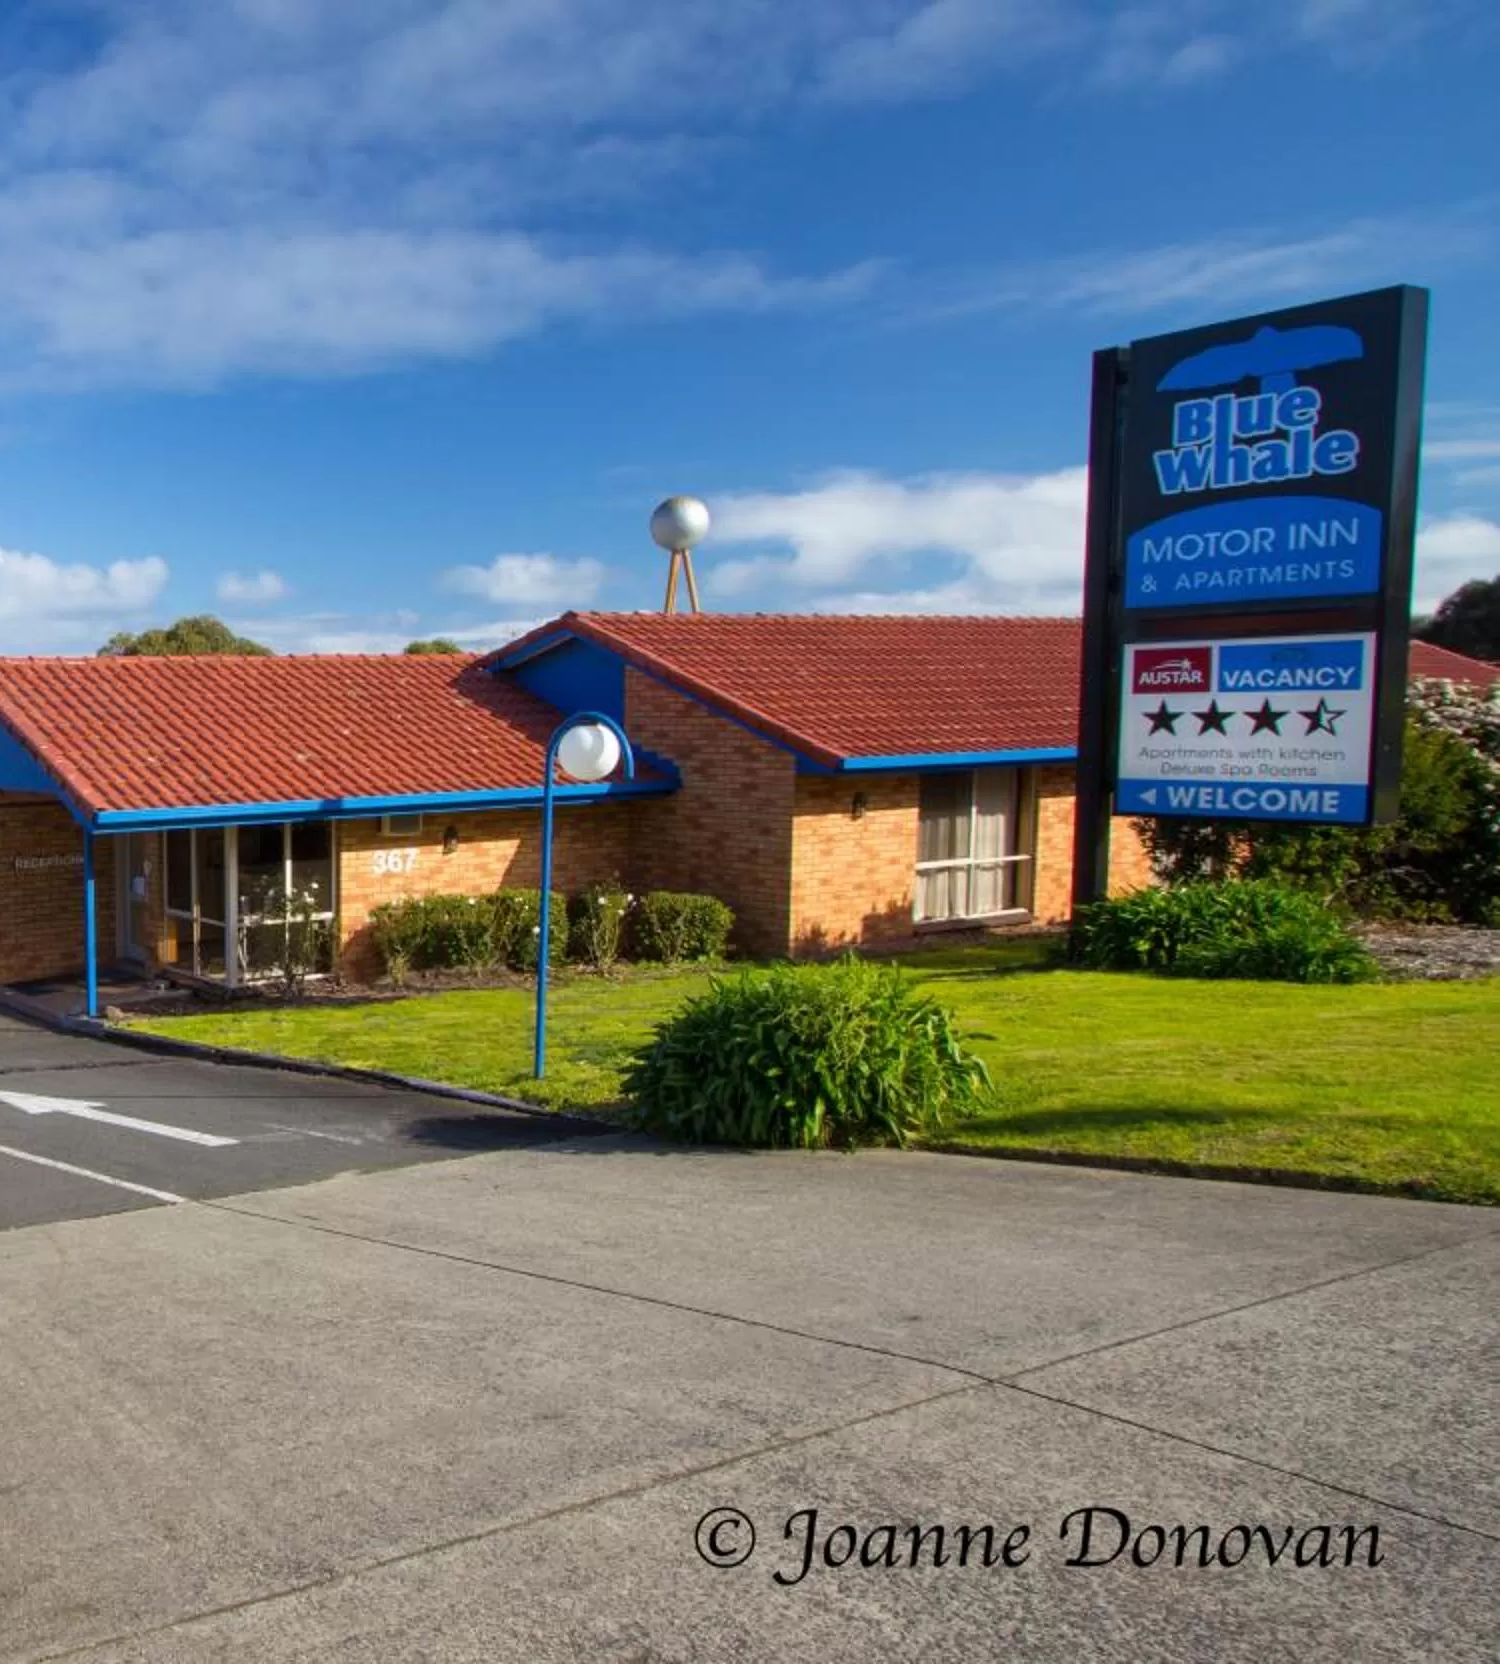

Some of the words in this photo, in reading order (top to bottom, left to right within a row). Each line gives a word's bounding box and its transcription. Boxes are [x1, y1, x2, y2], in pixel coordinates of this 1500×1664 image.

[1173, 386, 1322, 447] Blue
[1142, 526, 1276, 564] MOTOR
[1288, 518, 1359, 550] INN
[1140, 574, 1158, 593] &
[1174, 559, 1356, 591] APARTMENTS
[1138, 671, 1204, 686] AUSTAR
[1222, 666, 1356, 688] VACANCY
[1139, 746, 1233, 761] Apartments
[1239, 746, 1273, 760] with
[1279, 746, 1346, 761] kitchen
[1160, 761, 1215, 775] Deluxe
[1219, 762, 1253, 777] Spa
[1258, 763, 1317, 777] Rooms
[1168, 786, 1340, 814] WELCOME
[372, 848, 417, 874] 367
